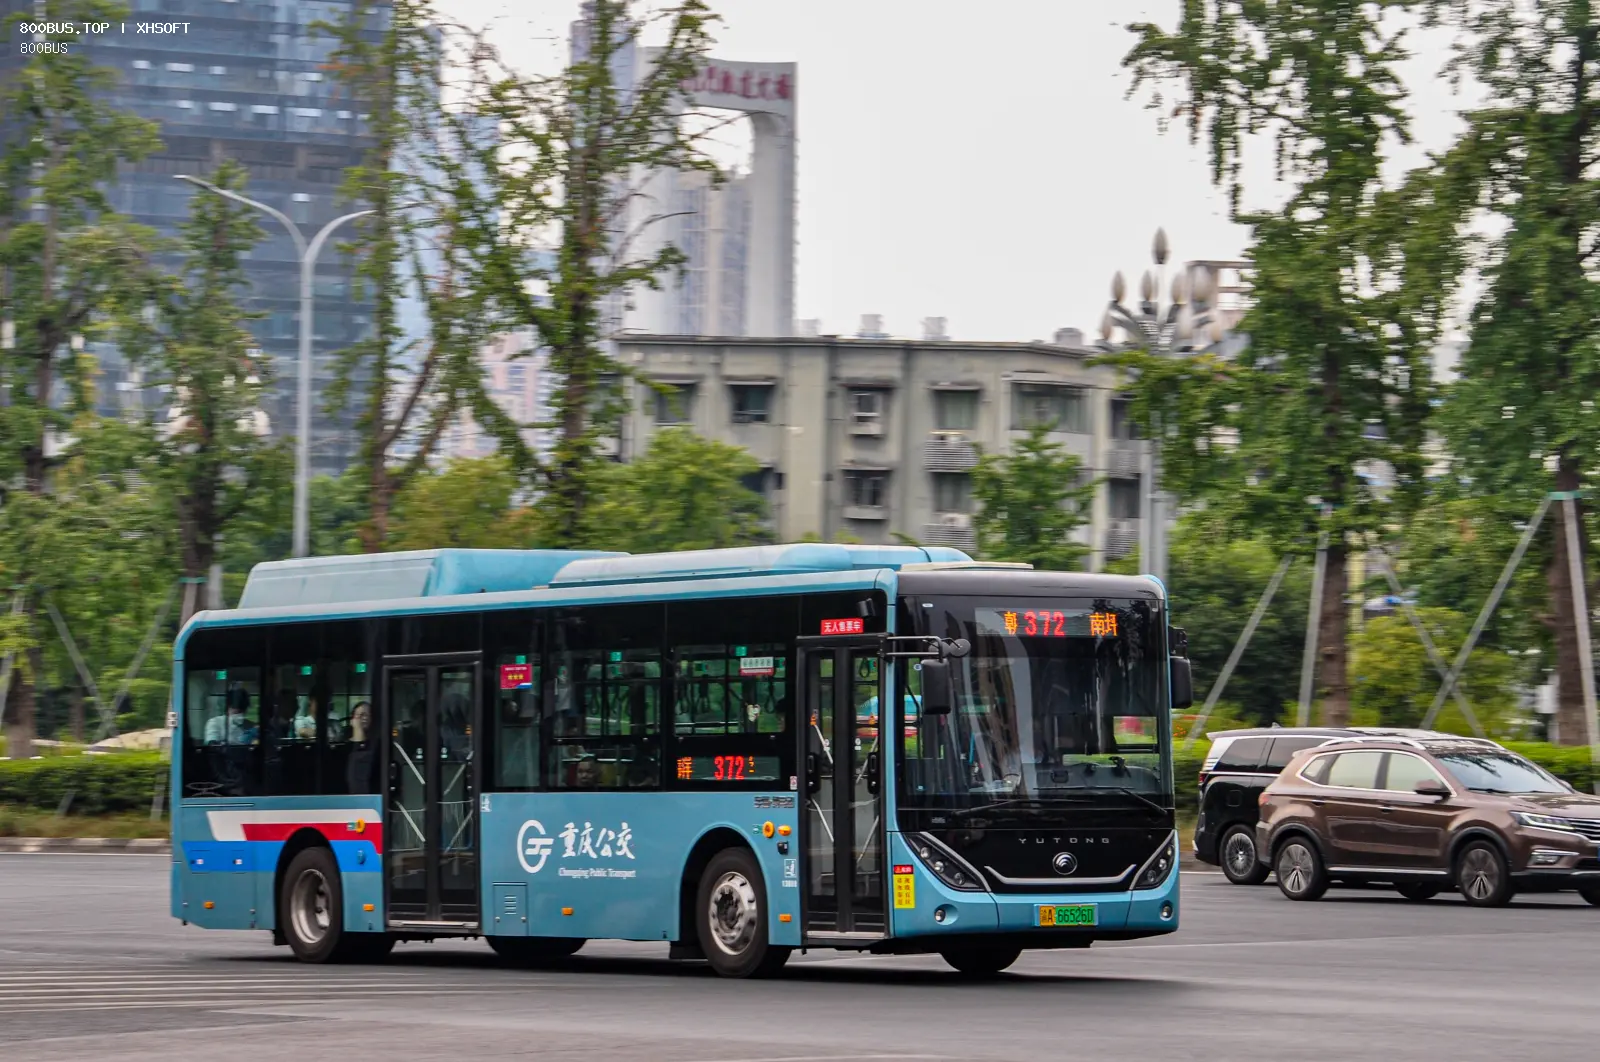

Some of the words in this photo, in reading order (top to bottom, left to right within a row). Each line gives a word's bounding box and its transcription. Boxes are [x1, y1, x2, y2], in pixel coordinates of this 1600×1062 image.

[1023, 610, 1065, 637] 372
[1089, 611, 1118, 637] 南坪
[714, 755, 745, 780] 372
[558, 821, 636, 860] 重庆公交
[1018, 837, 1110, 845] YUTONG
